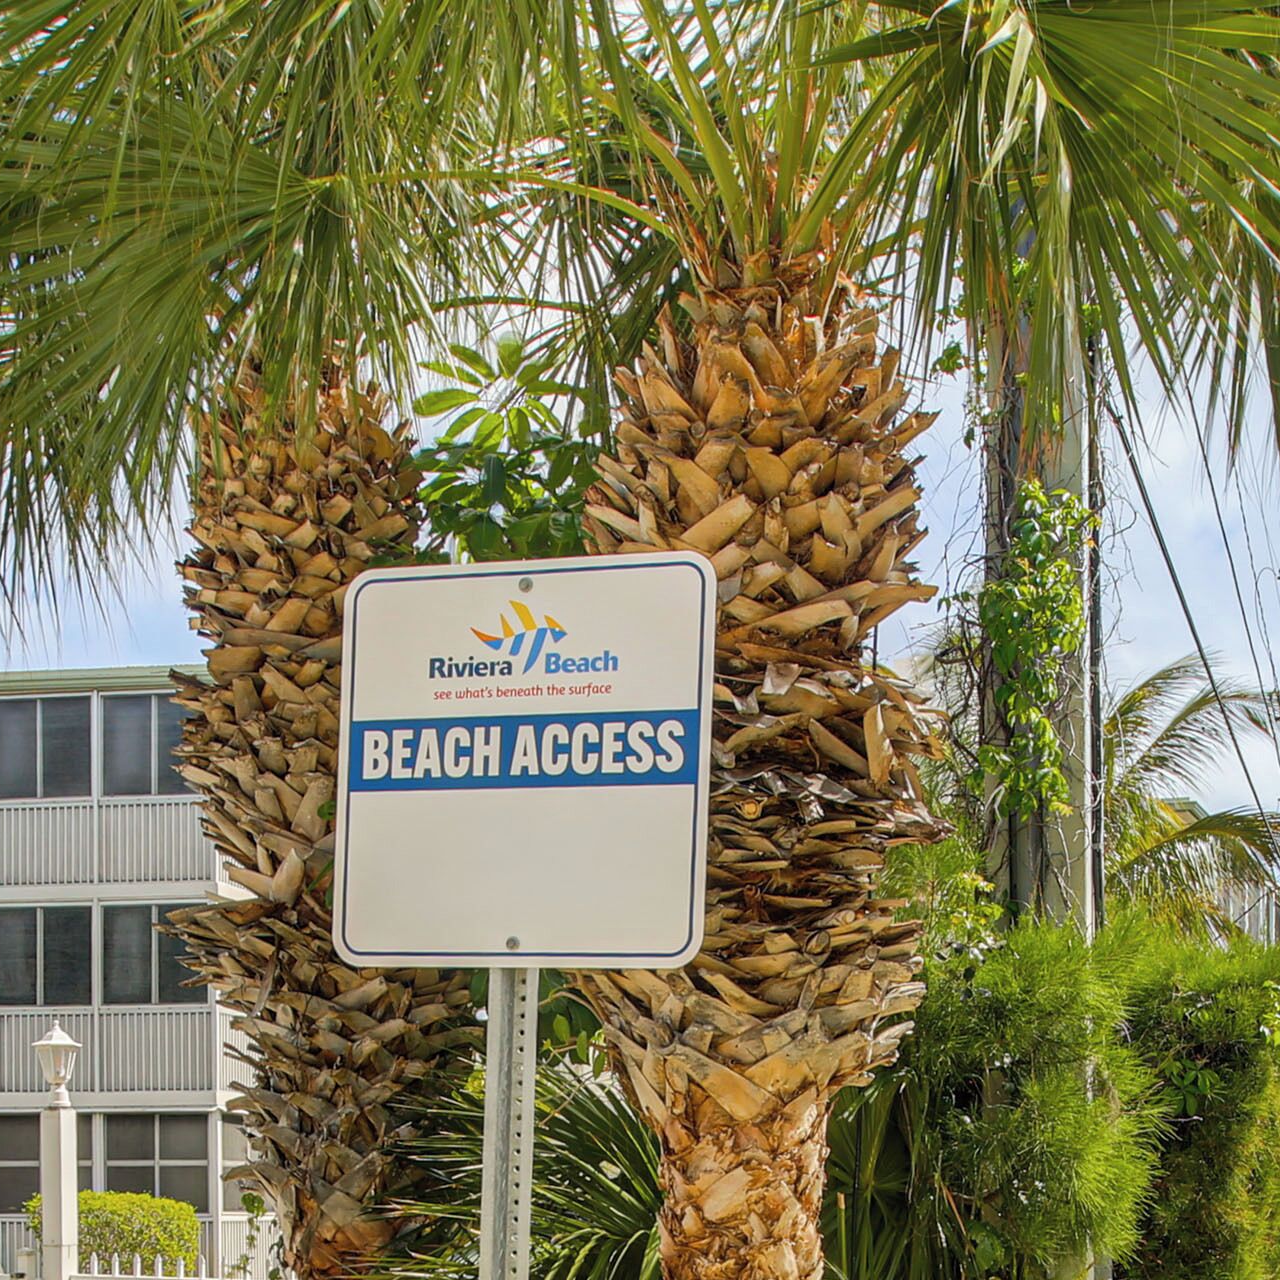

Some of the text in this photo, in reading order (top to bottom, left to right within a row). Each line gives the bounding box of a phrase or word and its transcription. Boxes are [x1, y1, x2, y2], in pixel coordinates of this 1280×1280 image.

[428, 650, 619, 679] Riviera Beach
[433, 681, 612, 700] see what's beneath the surface
[361, 719, 686, 780] BEACH ACCESS
